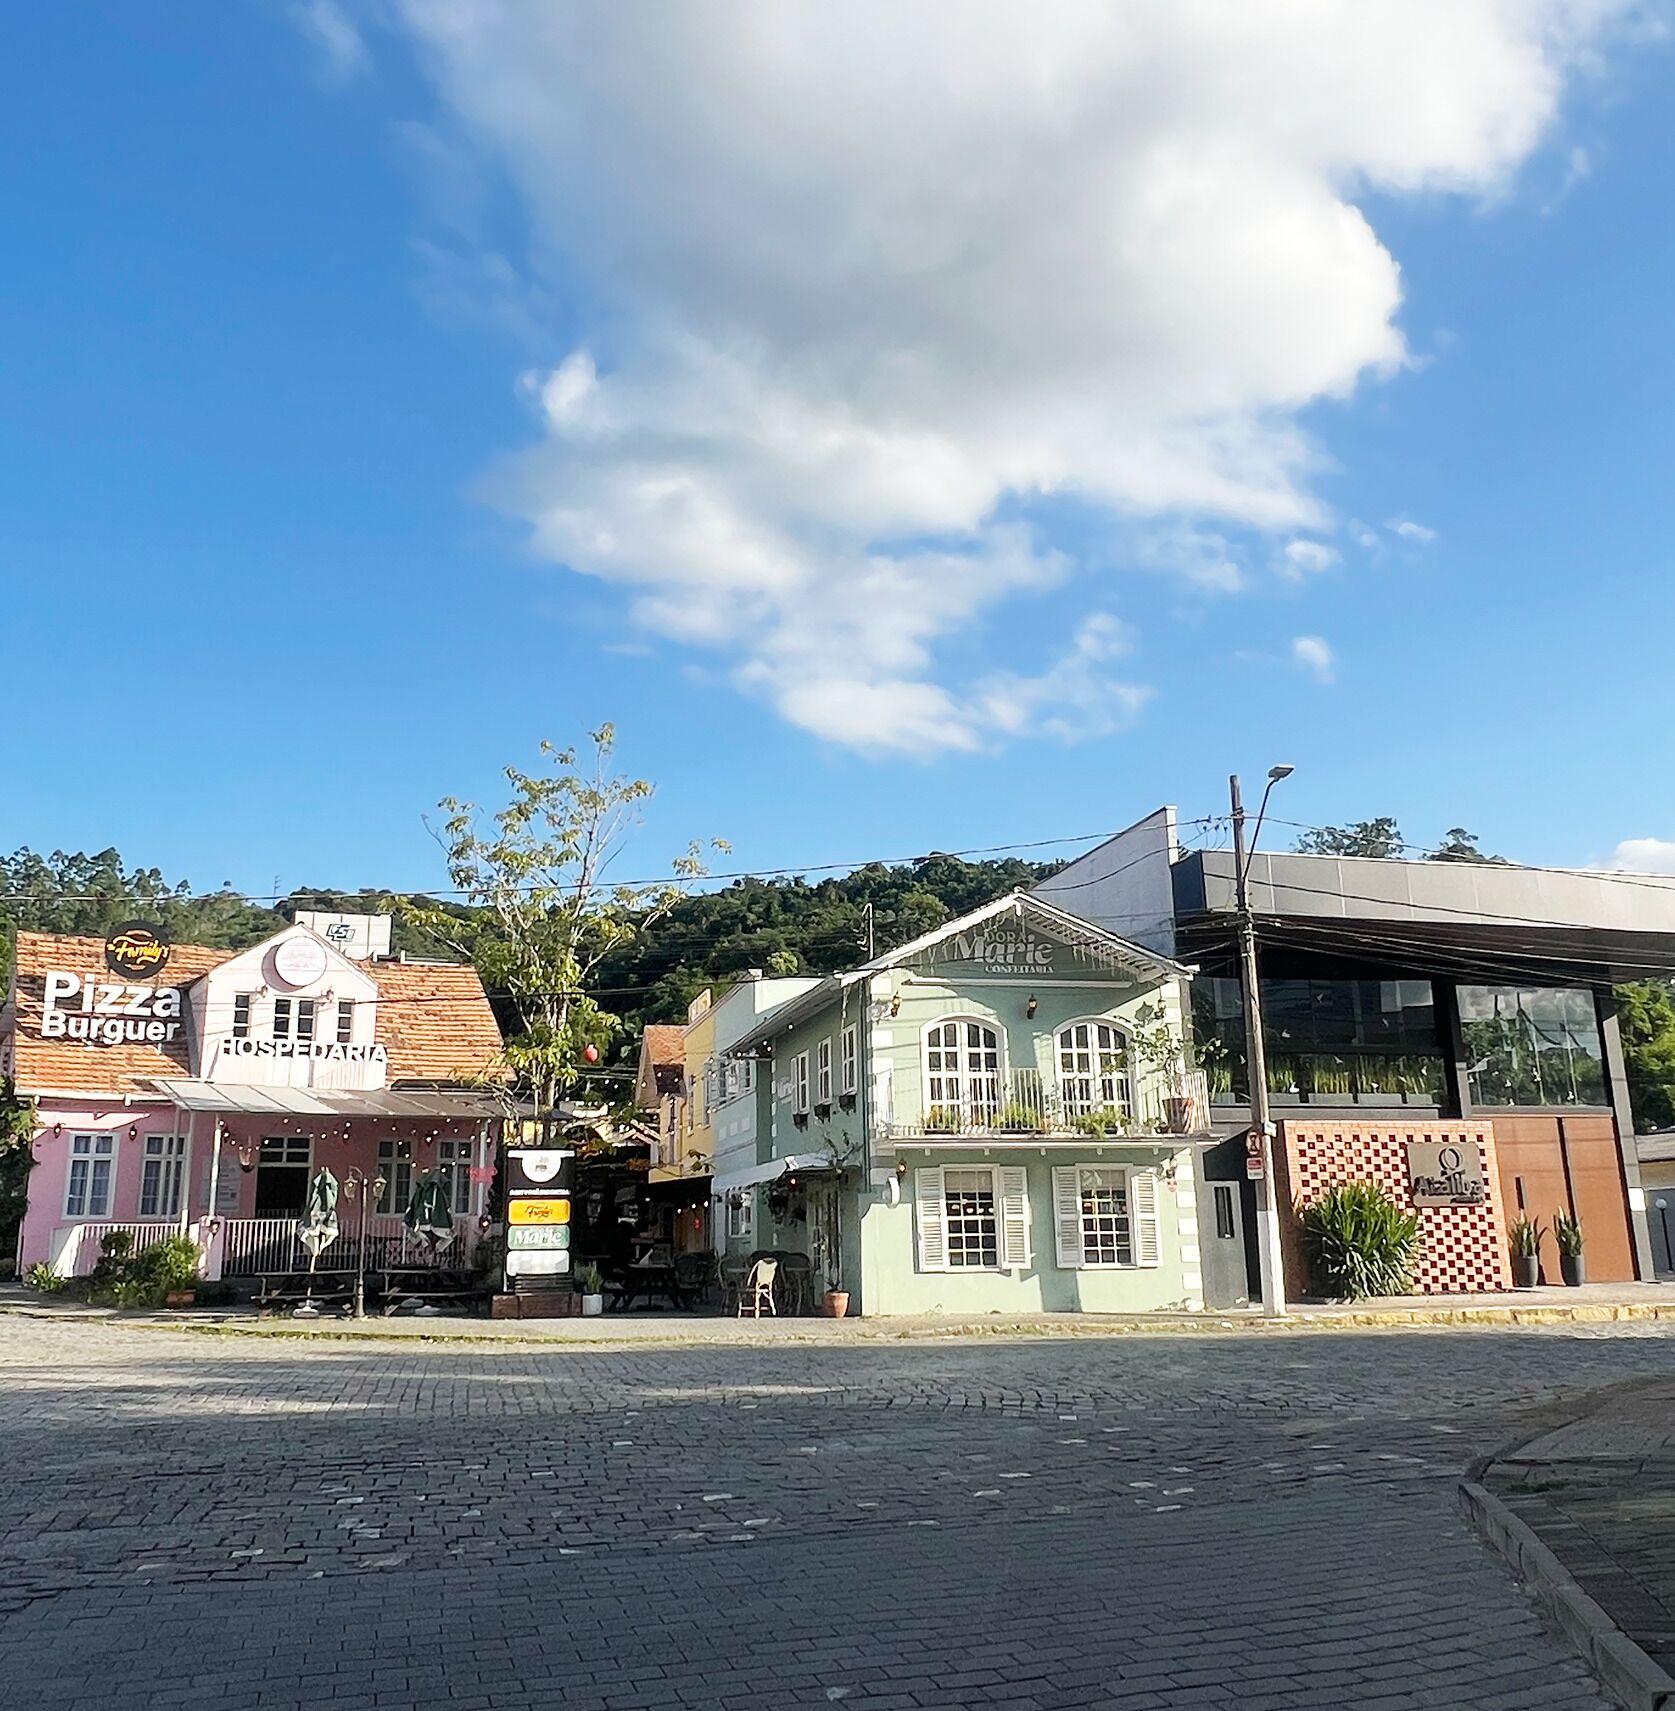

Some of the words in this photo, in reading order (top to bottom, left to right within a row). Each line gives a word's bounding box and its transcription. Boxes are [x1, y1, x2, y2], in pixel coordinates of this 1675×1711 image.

[953, 934, 1054, 964] Marie
[44, 971, 181, 1018] Pizza
[41, 1011, 181, 1045] Burguer
[221, 1038, 388, 1063] HOSPEDARIA
